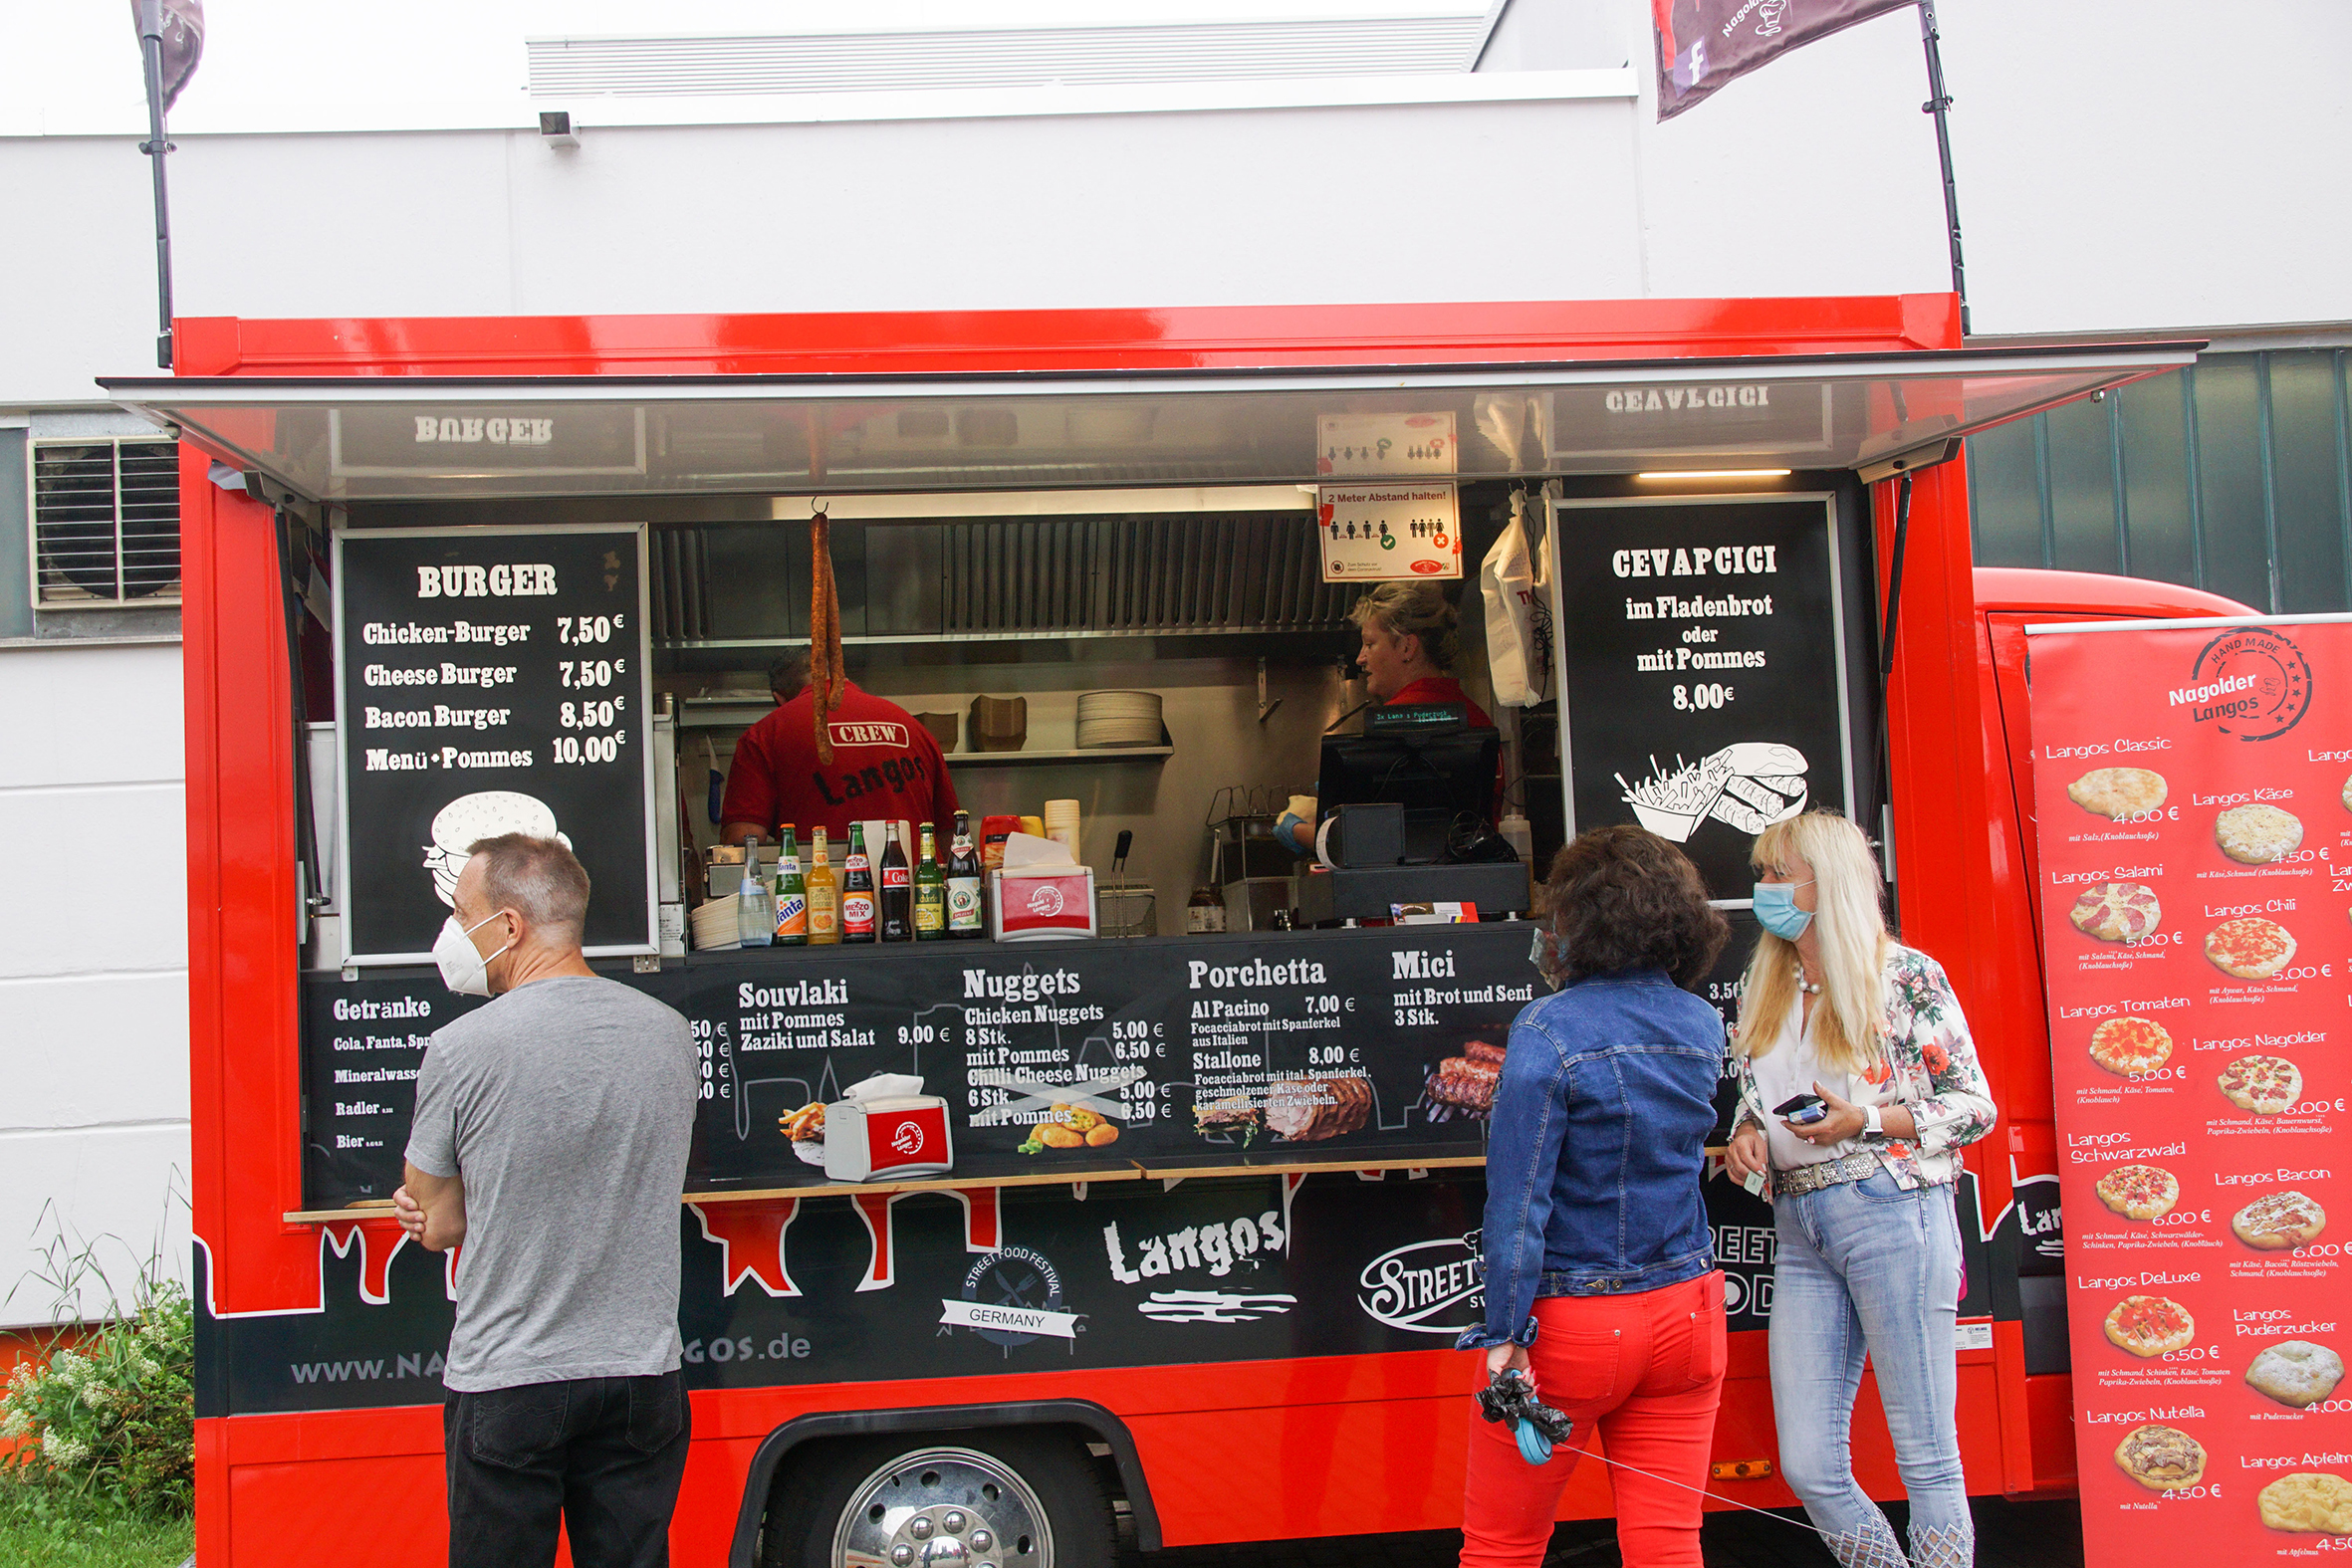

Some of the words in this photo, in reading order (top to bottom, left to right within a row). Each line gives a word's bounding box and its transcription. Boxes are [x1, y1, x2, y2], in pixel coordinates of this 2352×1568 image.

[1337, 494, 1366, 503] Meter
[1368, 493, 1410, 502] Abstand
[1411, 491, 1446, 501] halten!
[1612, 546, 1777, 577] CEVAPCICI
[417, 563, 558, 598] BURGER
[1626, 597, 1654, 619] im
[1656, 594, 1773, 619] Fladenbrot
[363, 620, 531, 646] Chicken-Burger
[1682, 625, 1719, 643] oder
[1637, 649, 1674, 672] mit
[1676, 647, 1766, 670] Pommes
[2211, 639, 2242, 664] HAND
[2245, 637, 2280, 654] MADE
[363, 664, 437, 688] Cheese
[440, 662, 517, 689] Burger
[2168, 673, 2257, 707] Nagolder
[364, 706, 431, 729] Bacon
[434, 704, 511, 731] Burger
[2193, 696, 2259, 723] Langos
[838, 725, 897, 743] CREW
[365, 748, 428, 772] Menü
[442, 747, 533, 770] Pommes
[2045, 743, 2110, 760] Langos
[2114, 737, 2173, 753] Classic
[812, 755, 925, 806] Langos
[2193, 790, 2250, 806] Langos
[2252, 786, 2293, 802] Käse
[2113, 808, 2164, 824] 4.00
[2168, 805, 2180, 820] €
[2270, 849, 2315, 865] 4.50
[2318, 846, 2330, 861] €
[2052, 868, 2110, 885] Langos
[2114, 863, 2164, 879] Salami
[845, 901, 869, 911] MEZZO
[2205, 901, 2262, 918] Langos
[2265, 898, 2296, 913] Chili
[2126, 934, 2169, 949] 5.00
[2172, 931, 2184, 945] €
[1188, 958, 1327, 990] Porchetta
[1392, 950, 1455, 980] Mici
[739, 979, 848, 1008] Souvlaki
[963, 968, 1080, 1003] Nuggets
[1393, 989, 1421, 1008] mit
[1424, 988, 1461, 1005] Brot
[1463, 986, 1494, 1004] und
[1496, 984, 1533, 1002] Senf
[333, 996, 431, 1020] Getränke
[965, 1008, 1033, 1025] Chicken
[1034, 1005, 1104, 1025] Nuggets
[1191, 1002, 1210, 1018] Al
[1212, 999, 1270, 1018] Pacino
[1304, 996, 1339, 1015] 7,00
[1344, 997, 1355, 1011] €
[1394, 1009, 1405, 1026] 3
[1407, 1008, 1439, 1026] Stk.
[2059, 1003, 2117, 1019] Langos
[2120, 996, 2191, 1012] Tomaten
[740, 1012, 770, 1031] mit
[772, 1011, 845, 1030] Pommes
[1191, 1019, 1262, 1035] Focacciabrot
[1263, 1020, 1281, 1032] mit
[1282, 1016, 1340, 1032] Spanferkel
[334, 1036, 365, 1050] Cola,
[365, 1035, 406, 1050] Fanta,
[740, 1030, 794, 1051] Zaziki
[796, 1031, 828, 1048] und
[830, 1028, 875, 1047] Salat
[897, 1024, 934, 1045] 9,00
[939, 1026, 950, 1042] €
[965, 1028, 976, 1045] 8
[978, 1027, 1012, 1044] Stk.
[1112, 1020, 1148, 1039] 5,00
[1153, 1022, 1164, 1037] €
[1192, 1036, 1210, 1047] aus
[1211, 1033, 1249, 1047] Italien
[2193, 1035, 2251, 1052] Langos
[2254, 1031, 2327, 1046] Nagolder
[966, 1051, 996, 1066] mit
[998, 1047, 1070, 1065] Pommes
[1114, 1040, 1150, 1059] 6,50
[1155, 1042, 1166, 1057] €
[1193, 1051, 1262, 1070] Stallone
[1308, 1046, 1344, 1065] 8,00
[1349, 1047, 1360, 1062] €
[968, 1068, 1012, 1086] Chilli
[1014, 1067, 1072, 1083] Cheese
[1074, 1063, 1145, 1083] Nuggets
[1194, 1071, 1266, 1086] Focacciabrot
[1267, 1070, 1284, 1083] mit
[1285, 1068, 1306, 1082] ital.
[968, 1089, 979, 1107] 6
[981, 1088, 1014, 1106] Stk.
[1119, 1081, 1155, 1100] 5,00
[1160, 1083, 1171, 1098] €
[1195, 1084, 1275, 1100] geschmolzener
[1304, 1081, 1328, 1094] oder
[2076, 1095, 2120, 1104] (Knoblauch)
[335, 1101, 379, 1116] Radler
[1195, 1097, 1285, 1111] karamellisierten
[1287, 1094, 1338, 1108] Zwiebeln.
[969, 1112, 998, 1127] mit
[1001, 1108, 1071, 1126] Pommes
[1120, 1101, 1156, 1120] 6,50
[1161, 1104, 1172, 1118] €
[336, 1134, 364, 1148] Bier
[2067, 1132, 2132, 1148] Langos
[2070, 1141, 2187, 1164] Schwarzwald
[2215, 1172, 2273, 1188] Langos
[2277, 1167, 2331, 1182] Bacon
[965, 1252, 997, 1289] STREET
[998, 1246, 1029, 1260] FOOD
[1029, 1251, 1061, 1298] FESTIVAL
[2078, 1274, 2137, 1291] Langos
[2140, 1270, 2202, 1286] DeLuxe
[1371, 1257, 1477, 1318] STREET
[969, 1307, 1046, 1329] GERMANY
[2234, 1308, 2292, 1322] Langos
[2235, 1320, 2338, 1336] Puderzucker
[2087, 1410, 2147, 1426] Langos
[2150, 1405, 2206, 1420] Nutella
[2240, 1455, 2297, 1469] Langos
